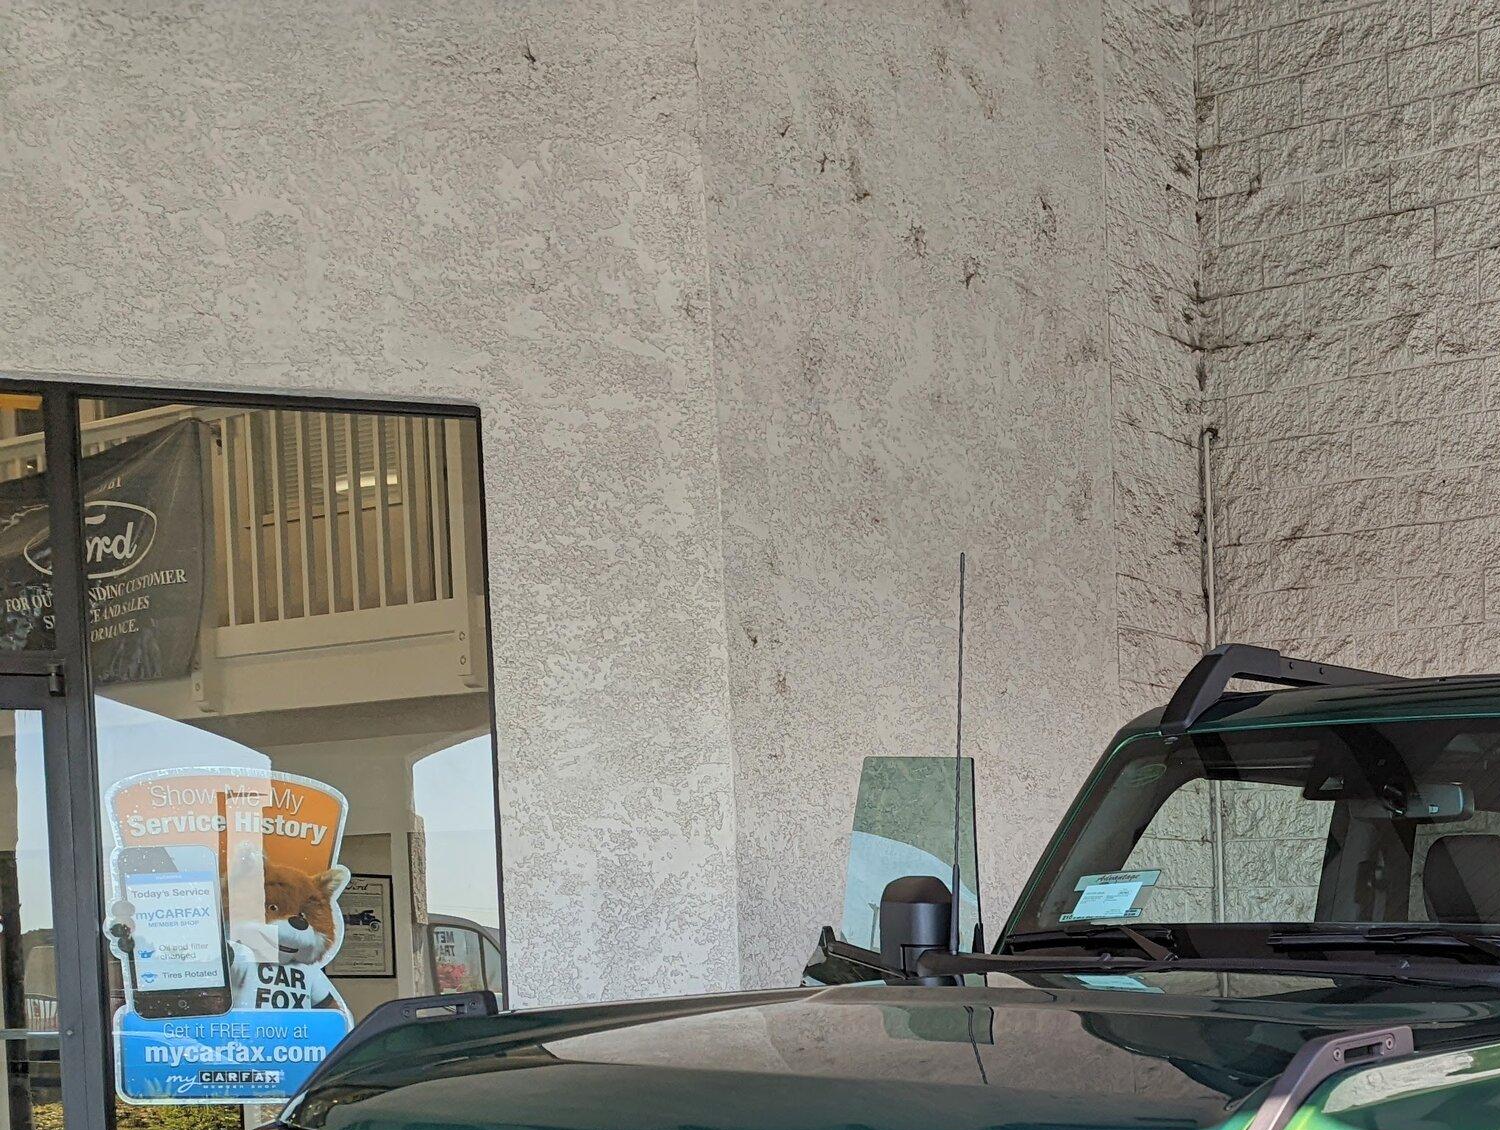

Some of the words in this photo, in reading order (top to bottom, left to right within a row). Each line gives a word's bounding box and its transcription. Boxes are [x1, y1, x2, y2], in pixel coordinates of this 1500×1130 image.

[5, 598, 30, 613] FOR
[32, 582, 126, 609] OUNDING
[126, 568, 188, 594] CUSTOMER
[150, 785, 215, 807] Show
[225, 785, 260, 806] Me
[271, 787, 304, 814] My
[126, 811, 227, 838] Service
[235, 811, 328, 845] History
[132, 889, 170, 899] Today's
[172, 888, 210, 897] Service
[135, 907, 210, 921] myCARFAX
[162, 971, 182, 979] Tires
[184, 969, 218, 978] Rotated
[257, 963, 306, 989] CAR
[255, 987, 305, 1009] FOX
[163, 1023, 190, 1039] Get
[195, 1023, 205, 1038] it
[210, 1023, 251, 1038] FREE
[256, 1026, 288, 1038] now
[293, 1024, 308, 1038] at
[145, 1041, 326, 1067] mycarfax.com
[200, 1070, 280, 1083] CARFAX
